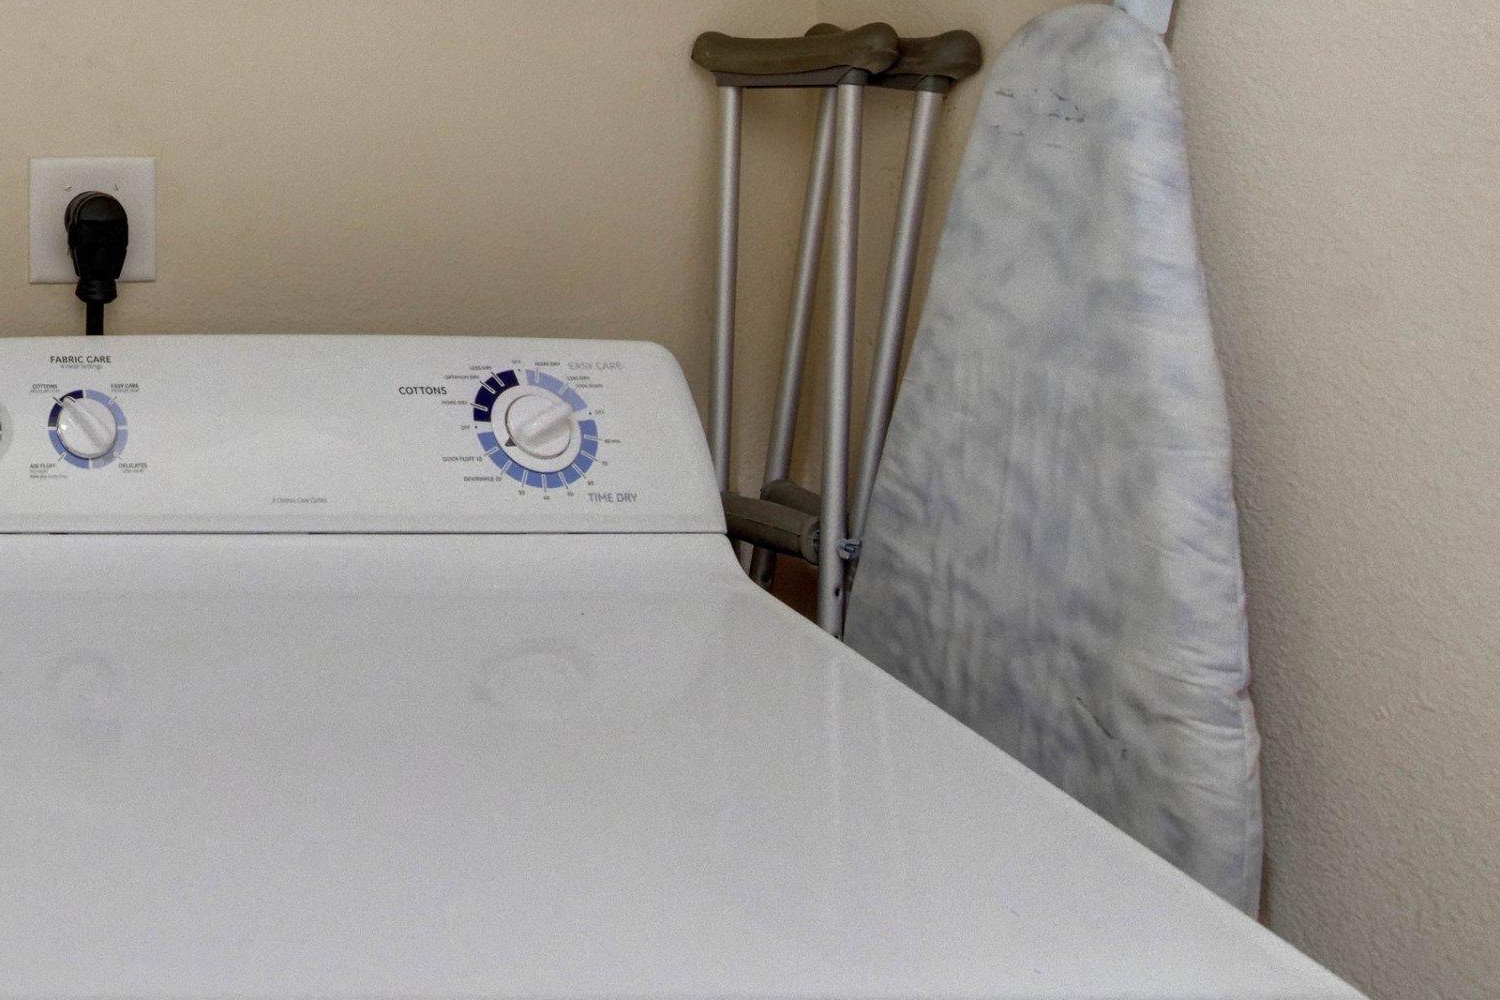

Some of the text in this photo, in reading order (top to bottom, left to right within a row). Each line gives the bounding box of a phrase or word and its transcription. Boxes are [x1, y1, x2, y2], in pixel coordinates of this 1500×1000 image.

[50, 356, 112, 364] FABRIC CARE
[567, 361, 623, 370] EASY CARE
[398, 386, 448, 395] COTTONS
[588, 493, 637, 503] TIME DRY
